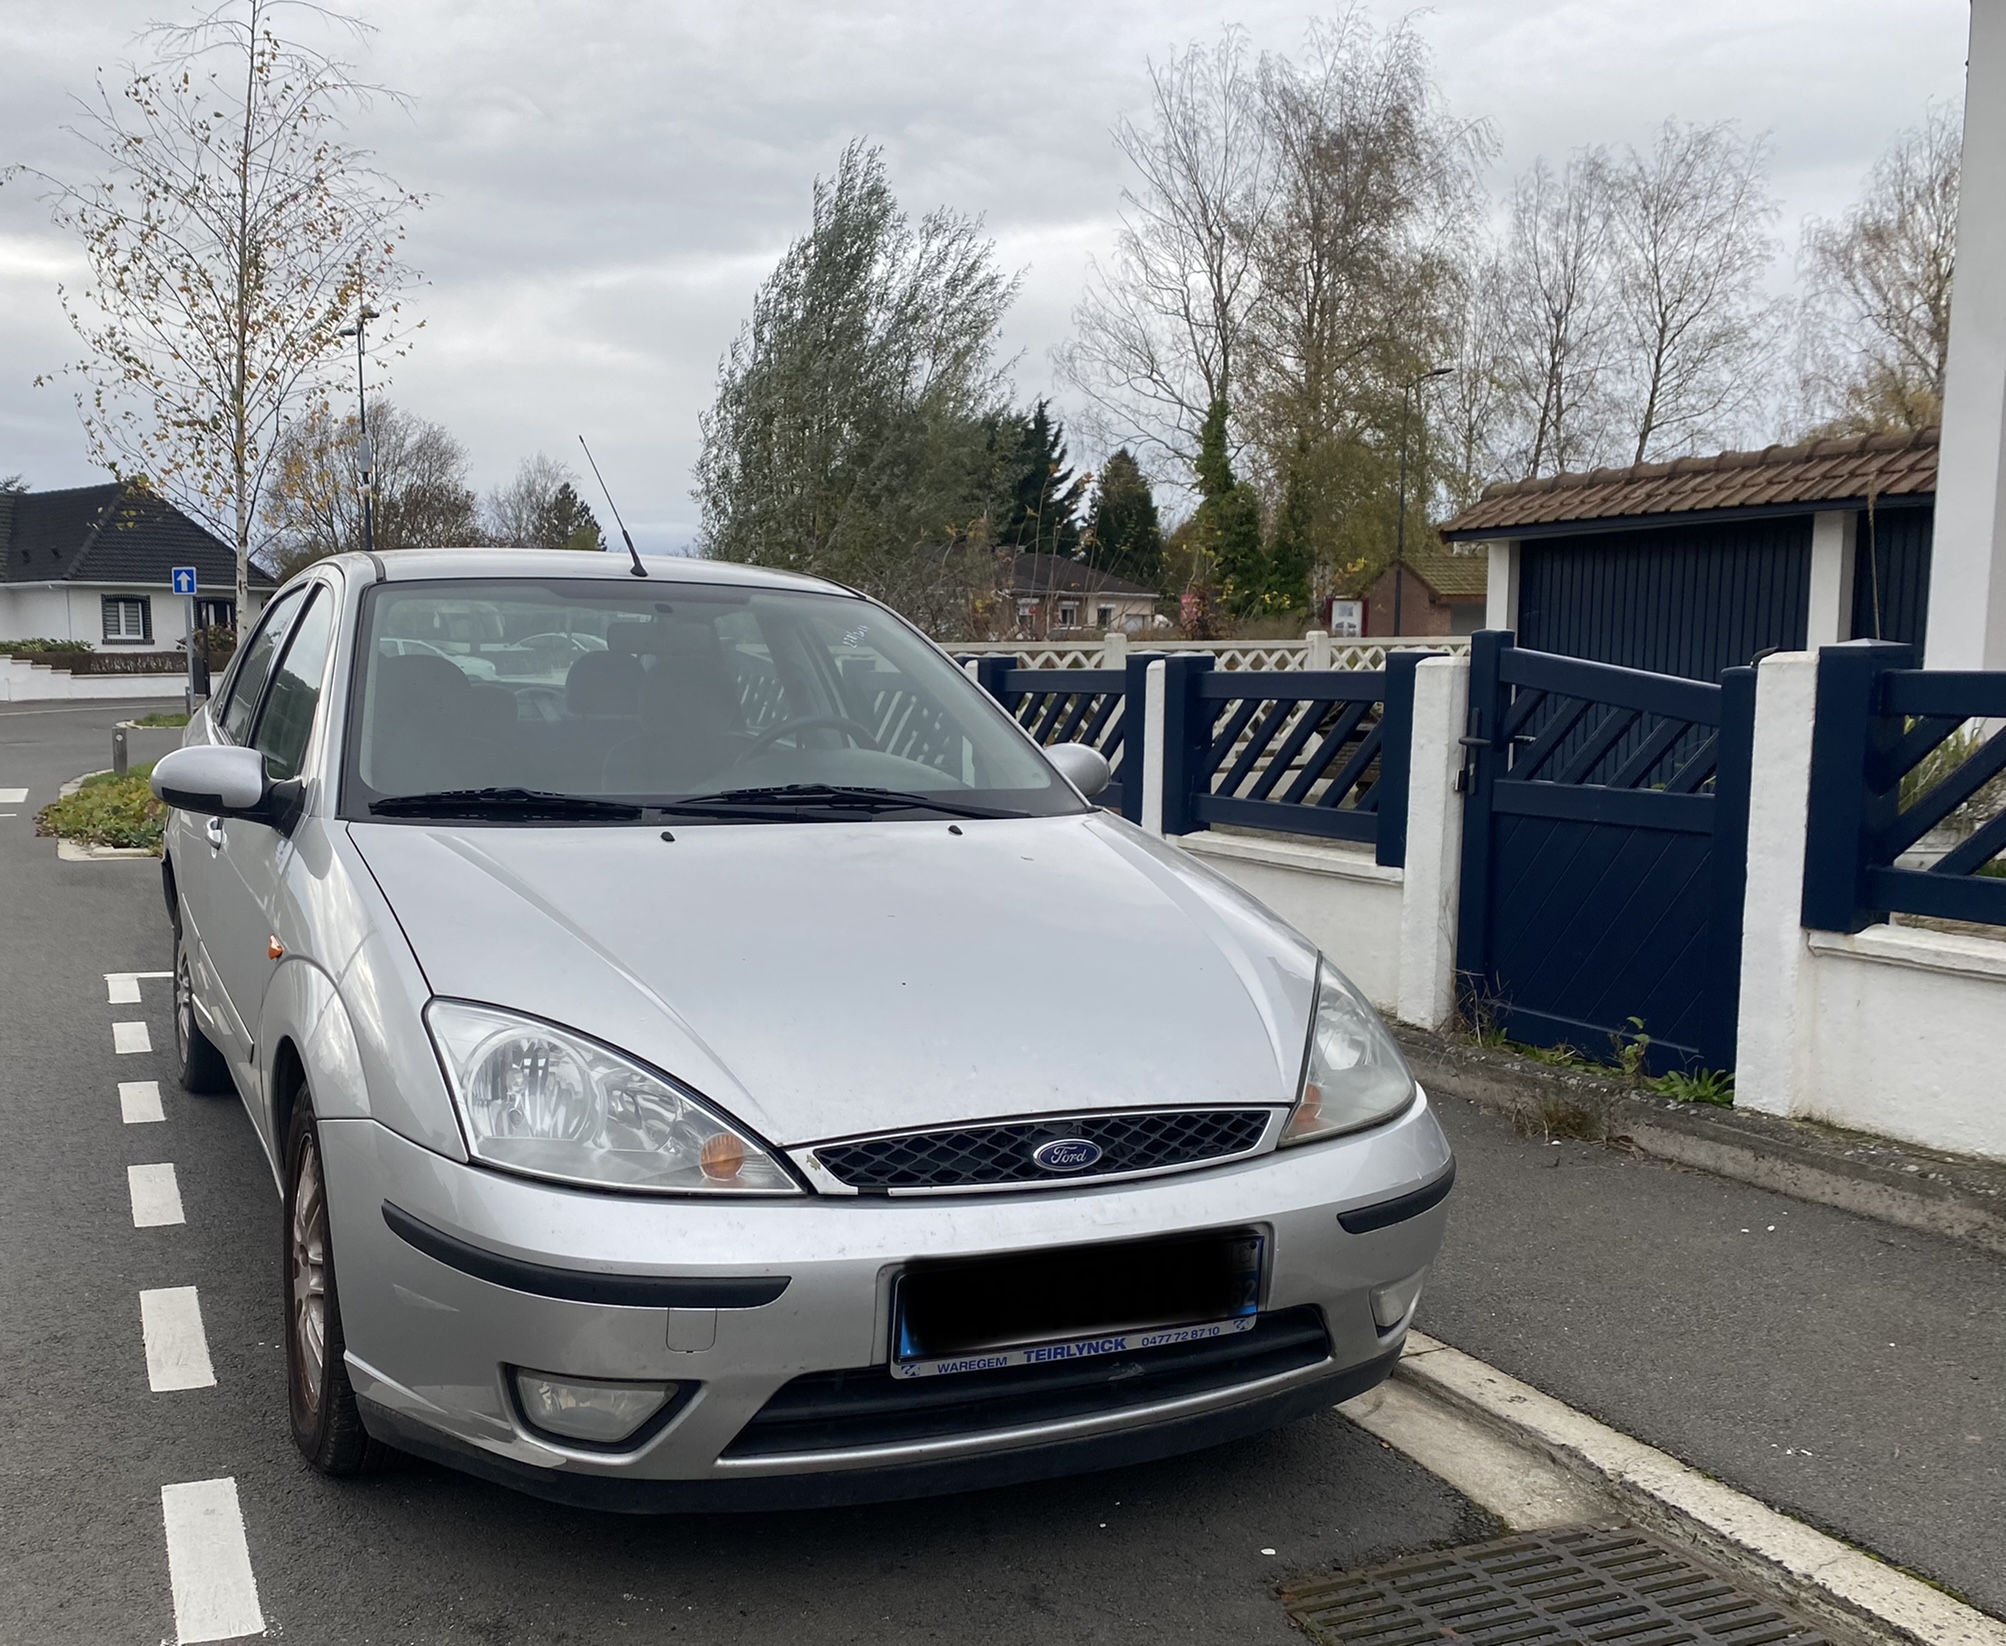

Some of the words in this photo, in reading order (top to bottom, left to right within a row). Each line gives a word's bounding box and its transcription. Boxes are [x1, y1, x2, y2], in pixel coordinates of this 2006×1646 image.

[1050, 1146, 1087, 1164] Ford
[937, 1356, 1008, 1374] WAREGEM
[1023, 1337, 1127, 1363] TEIRLYNCK
